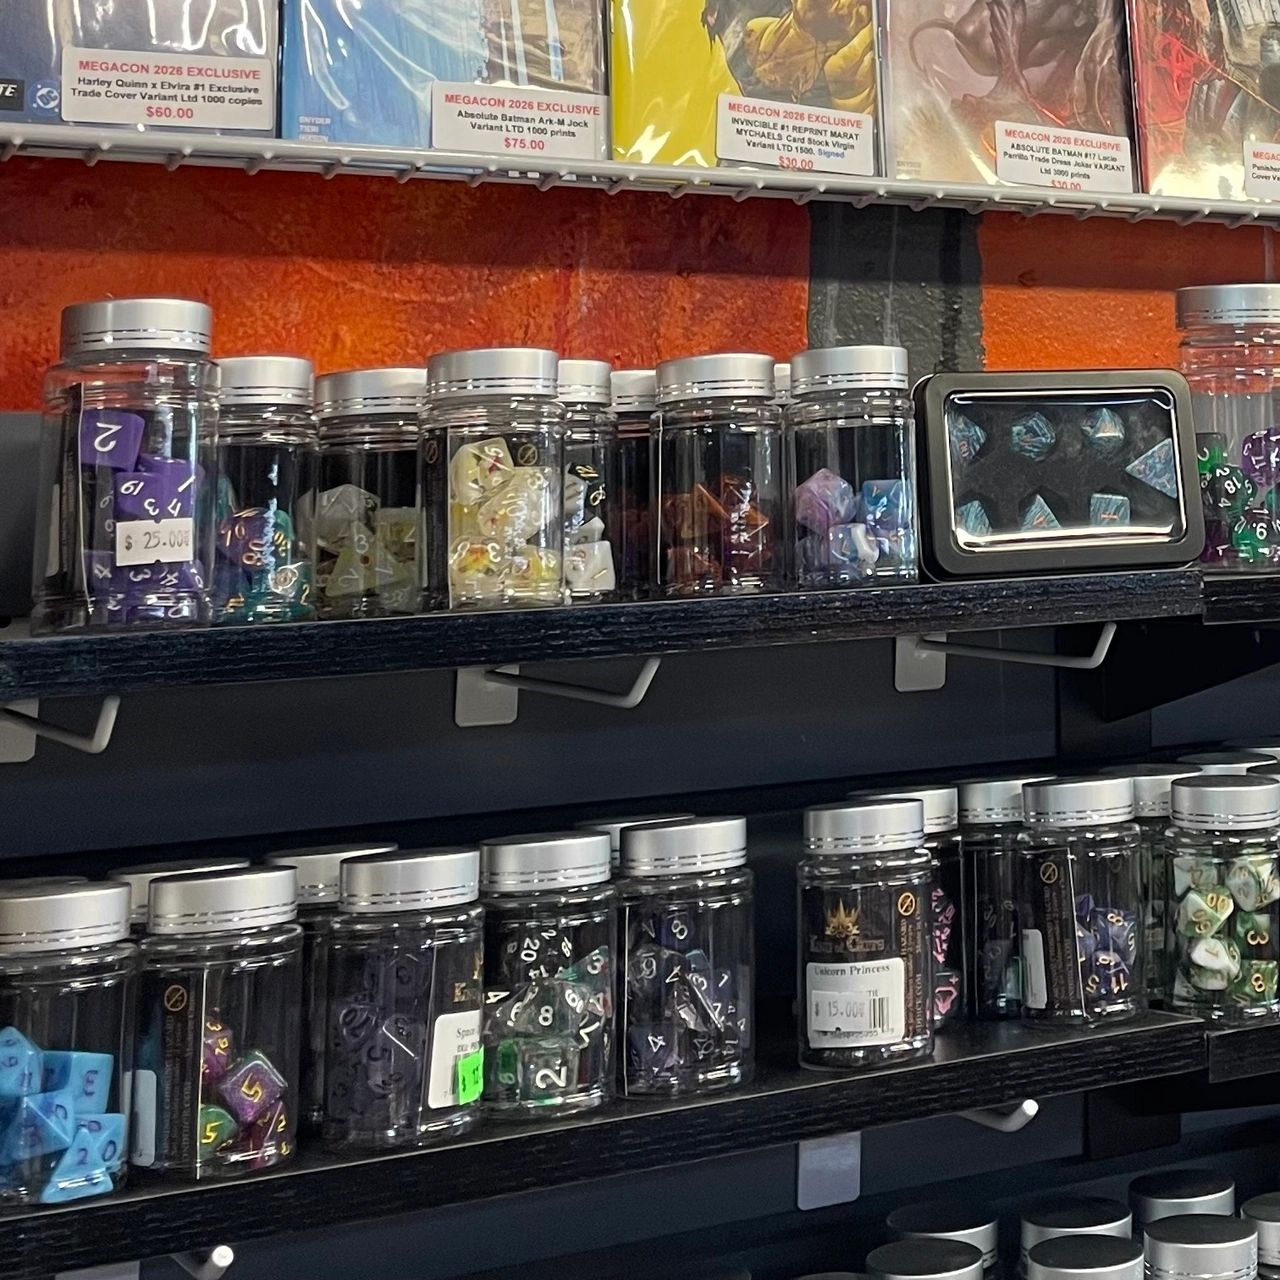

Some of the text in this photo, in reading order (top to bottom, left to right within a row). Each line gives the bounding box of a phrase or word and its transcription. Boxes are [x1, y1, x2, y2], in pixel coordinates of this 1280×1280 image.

[78, 60, 261, 79] MEGACON 2026 EXCLUSIVE
[78, 76, 112, 89] Harley
[115, 79, 148, 89] Quinn
[161, 81, 191, 91] Elvira
[193, 83, 206, 92] #1
[209, 84, 259, 94] Exclusive
[71, 88, 262, 106] Trade Cover Variant Ltd 1000 copies
[444, 93, 600, 116] MEGACON 2026 EXCLUSIVE
[146, 106, 194, 119] $60.00
[457, 110, 588, 129] Absolute Batman Ark-M Jock
[728, 102, 863, 129] MEGACON 2026 EXCLUSIVE
[470, 122, 576, 139] Variant LTD 1000 prints
[731, 117, 778, 131] INVINCIBLE
[792, 126, 828, 137] REPRINT
[830, 131, 859, 141] MARAT
[736, 128, 782, 141] MYCHAELS
[786, 134, 805, 144] Card
[504, 137, 545, 151] $75.00
[746, 140, 774, 150] Variant
[776, 144, 793, 153] LTD
[1004, 128, 1050, 143] MEGACON
[1074, 138, 1121, 152] EXCLUSIVE
[1010, 143, 1050, 155] ABSOLUTE
[1052, 148, 1082, 159] BATMAN
[850, 965, 890, 976] Princess
